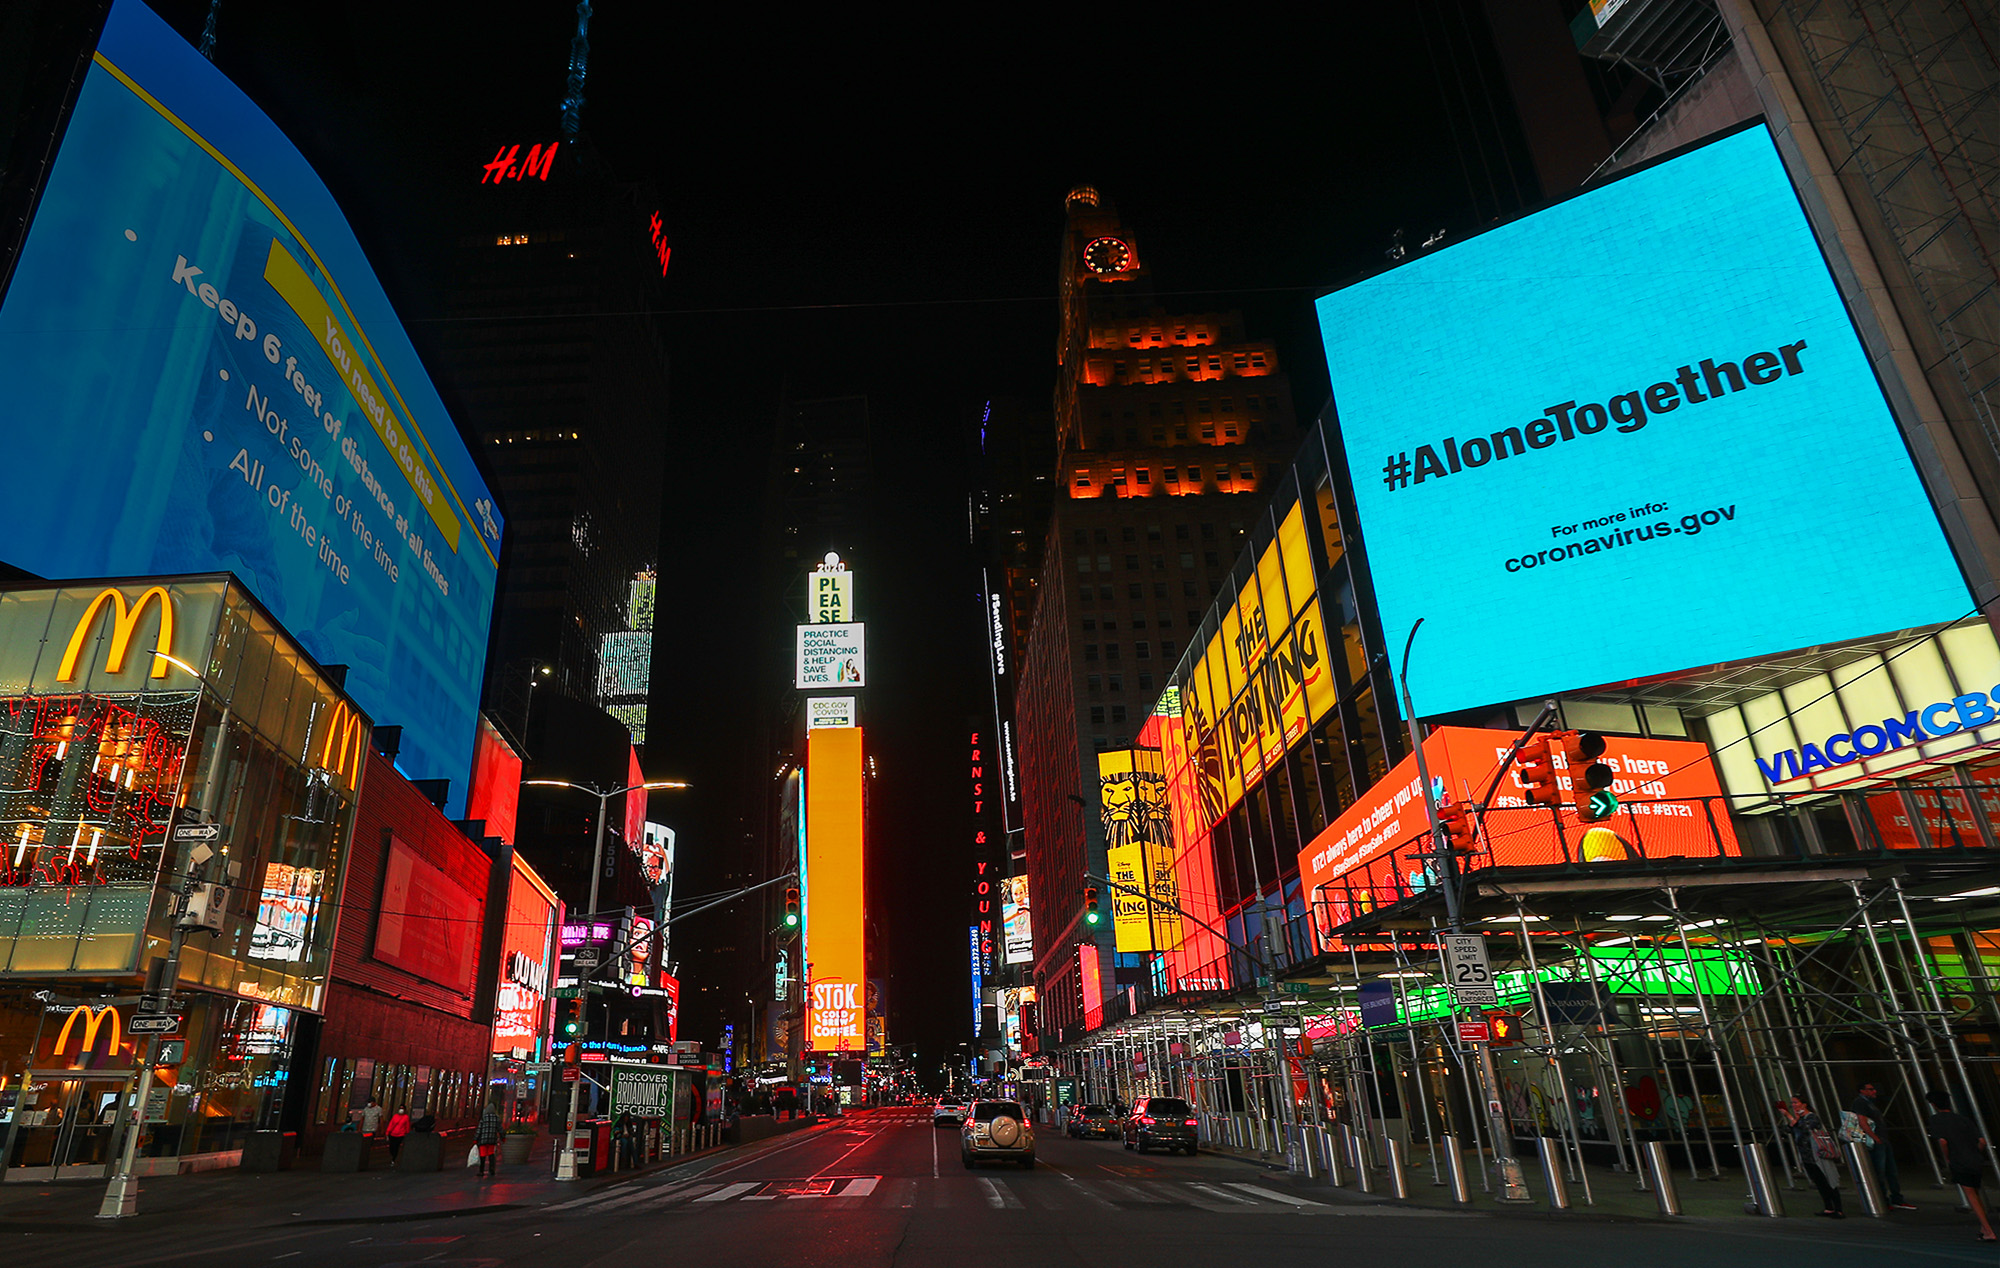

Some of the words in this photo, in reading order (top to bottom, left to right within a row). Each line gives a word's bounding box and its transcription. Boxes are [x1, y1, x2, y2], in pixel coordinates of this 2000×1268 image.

[481, 142, 559, 184] H&M
[649, 210, 671, 278] H&M
[325, 315, 352, 374] You
[352, 368, 385, 427] need
[385, 419, 398, 448] to
[399, 444, 414, 473] do
[414, 465, 434, 505] this
[1382, 338, 1807, 492] #AloneTogether
[171, 254, 257, 341] Keep
[263, 333, 282, 364] 6
[285, 356, 322, 418] feet
[323, 411, 342, 441] of
[341, 437, 395, 520] distance
[395, 514, 409, 540] at
[408, 532, 423, 559] all
[423, 548, 449, 596] times
[246, 384, 288, 445] Not
[290, 437, 333, 500] some
[335, 494, 352, 521] of
[352, 510, 373, 550] the
[373, 539, 399, 583] time
[228, 448, 265, 491] All
[268, 484, 291, 514] of
[290, 502, 316, 547] the
[318, 535, 350, 585] time
[1551, 524, 1579, 537] For
[1582, 512, 1626, 531] more
[1628, 500, 1669, 520] info:
[1504, 504, 1737, 573] coronavirus.gov
[817, 562, 846, 573] 2020
[803, 630, 849, 638] PRACTICE
[803, 639, 837, 647] SOCIAL
[991, 593, 1005, 675] #SendingLove
[1235, 606, 1266, 668] THE
[803, 647, 858, 656] DISTANCING
[803, 657, 810, 665] &
[812, 656, 836, 665] HELP
[803, 665, 826, 673] SAVE
[803, 674, 830, 683] LIVES.
[1258, 619, 1319, 737] KING
[1264, 752, 1272, 764] ON
[1285, 723, 1299, 744] STREET
[971, 732, 984, 813] ERNST
[1621, 753, 1670, 775] here
[1639, 780, 1666, 799] up
[1653, 804, 1693, 817] #BT21
[178, 828, 191, 836] ONE
[1311, 851, 1327, 874] BT21
[1326, 837, 1348, 864] always
[1346, 823, 1364, 847] here
[1361, 817, 1371, 834] to
[1370, 799, 1393, 828] cheer
[1393, 785, 1411, 814] you
[1410, 775, 1424, 797] up
[975, 831, 987, 844] &
[605, 835, 616, 878] 1500
[1116, 870, 1135, 880] THE
[977, 862, 992, 954] YOUNG
[1114, 898, 1146, 917] KING
[971, 929, 981, 976] 212.372.2349
[514, 950, 530, 984] OLD
[529, 959, 548, 1002] NAVY
[1456, 963, 1487, 982] 25
[564, 989, 572, 997] 45
[1294, 983, 1302, 991] 45
[134, 1020, 149, 1028] ONE
[156, 1020, 172, 1028] WAY
[822, 1010, 848, 1018] COLD
[822, 1018, 848, 1026] BREW
[813, 1023, 857, 1037] COFFEE
[618, 1072, 668, 1083] DISCOVER
[616, 1080, 668, 1107] BROADWAY'S
